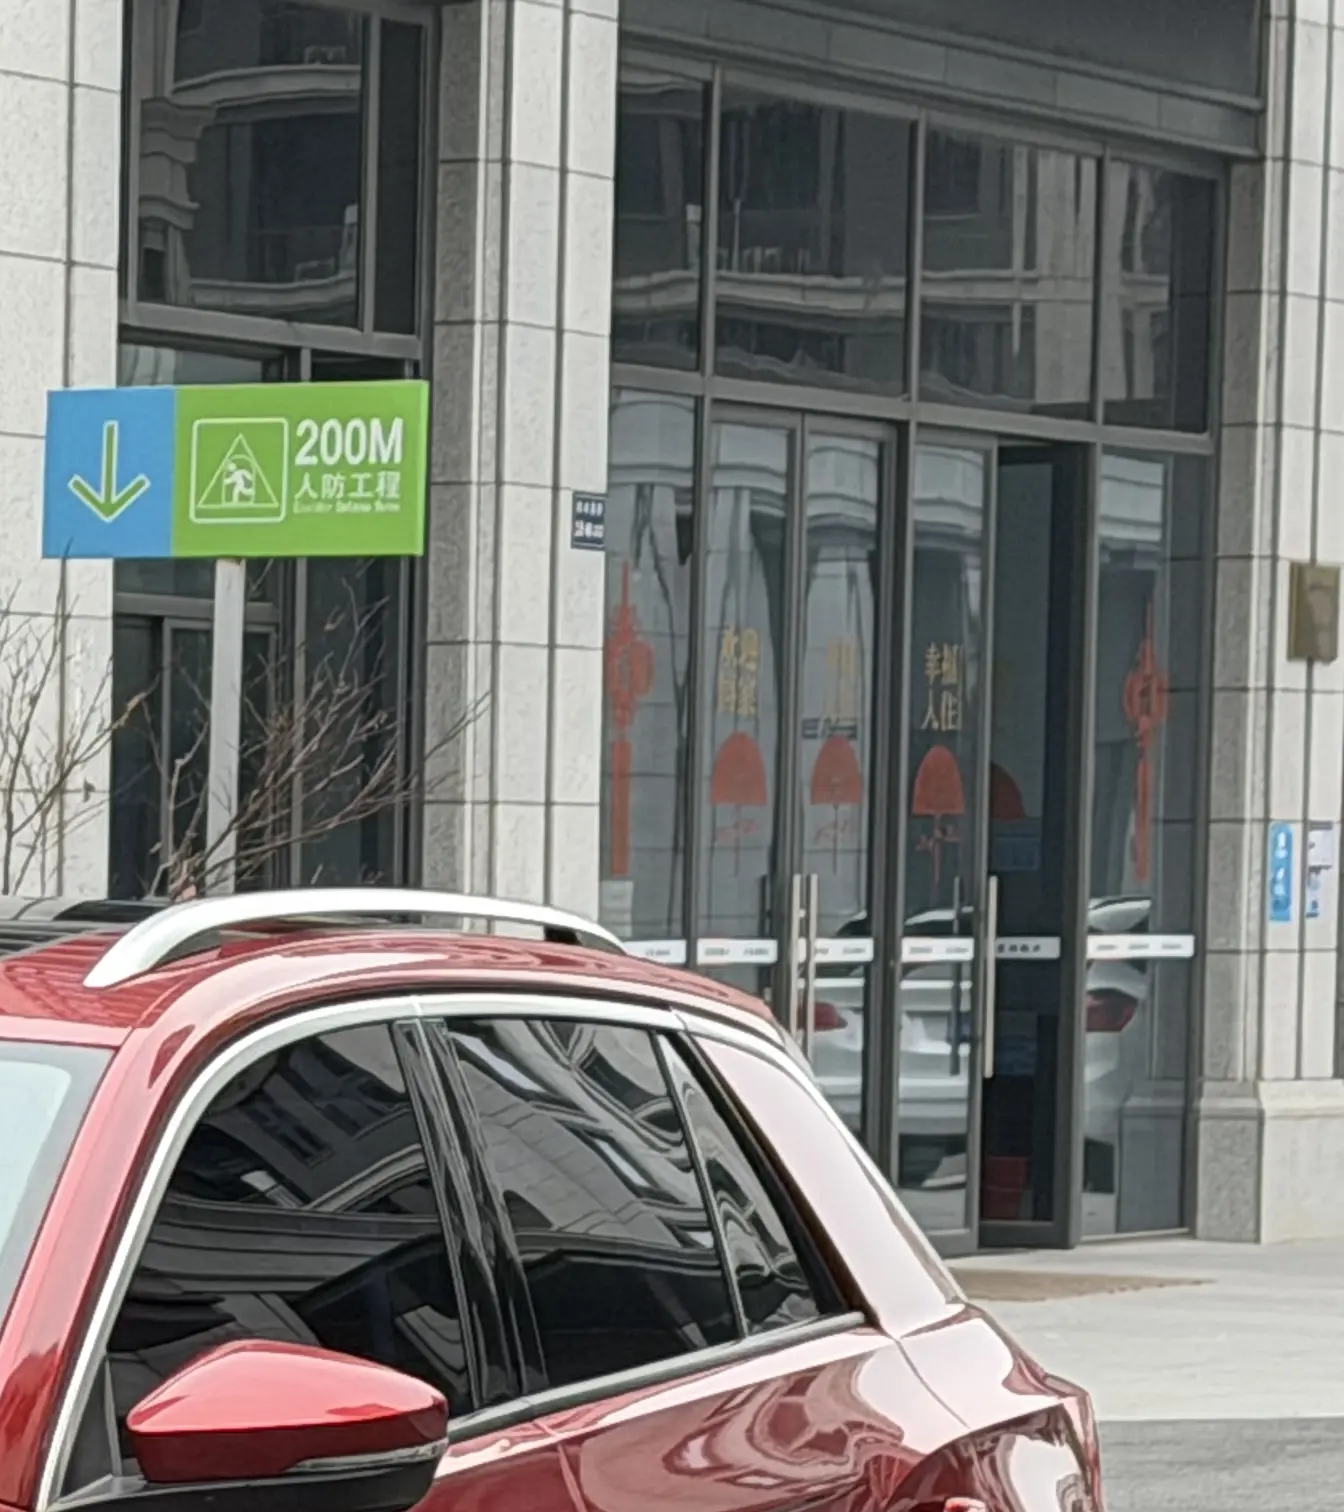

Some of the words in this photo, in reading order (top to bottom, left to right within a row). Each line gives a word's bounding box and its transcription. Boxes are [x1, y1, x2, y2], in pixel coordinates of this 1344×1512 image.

[295, 417, 403, 465] 200M
[294, 471, 400, 499] 人防工程
